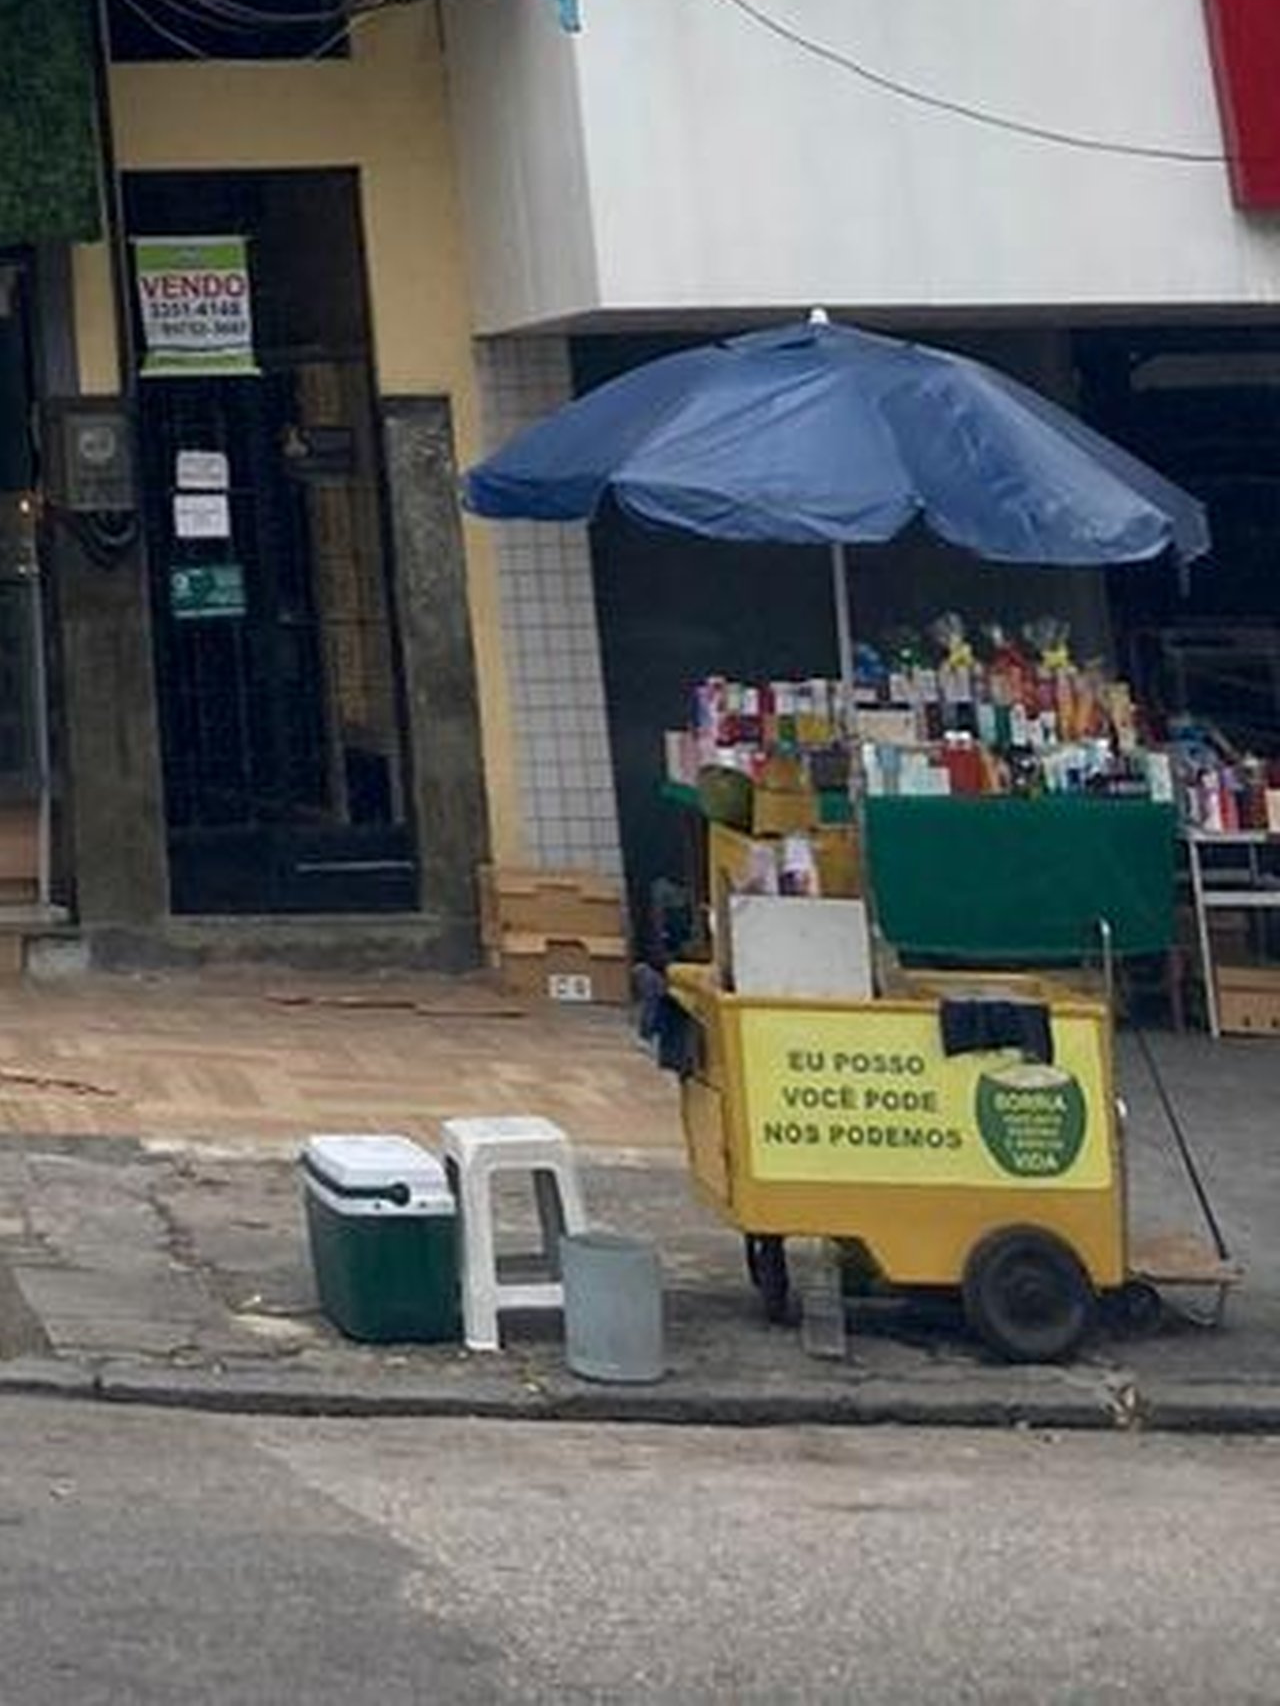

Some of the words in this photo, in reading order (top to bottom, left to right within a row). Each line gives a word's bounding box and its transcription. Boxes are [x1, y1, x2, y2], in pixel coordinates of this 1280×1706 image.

[141, 273, 246, 299] VENDO
[785, 1051, 824, 1073] EU
[833, 1052, 925, 1076] POSSO
[864, 1089, 938, 1113] PODE
[828, 1124, 963, 1150] PODEMOS
